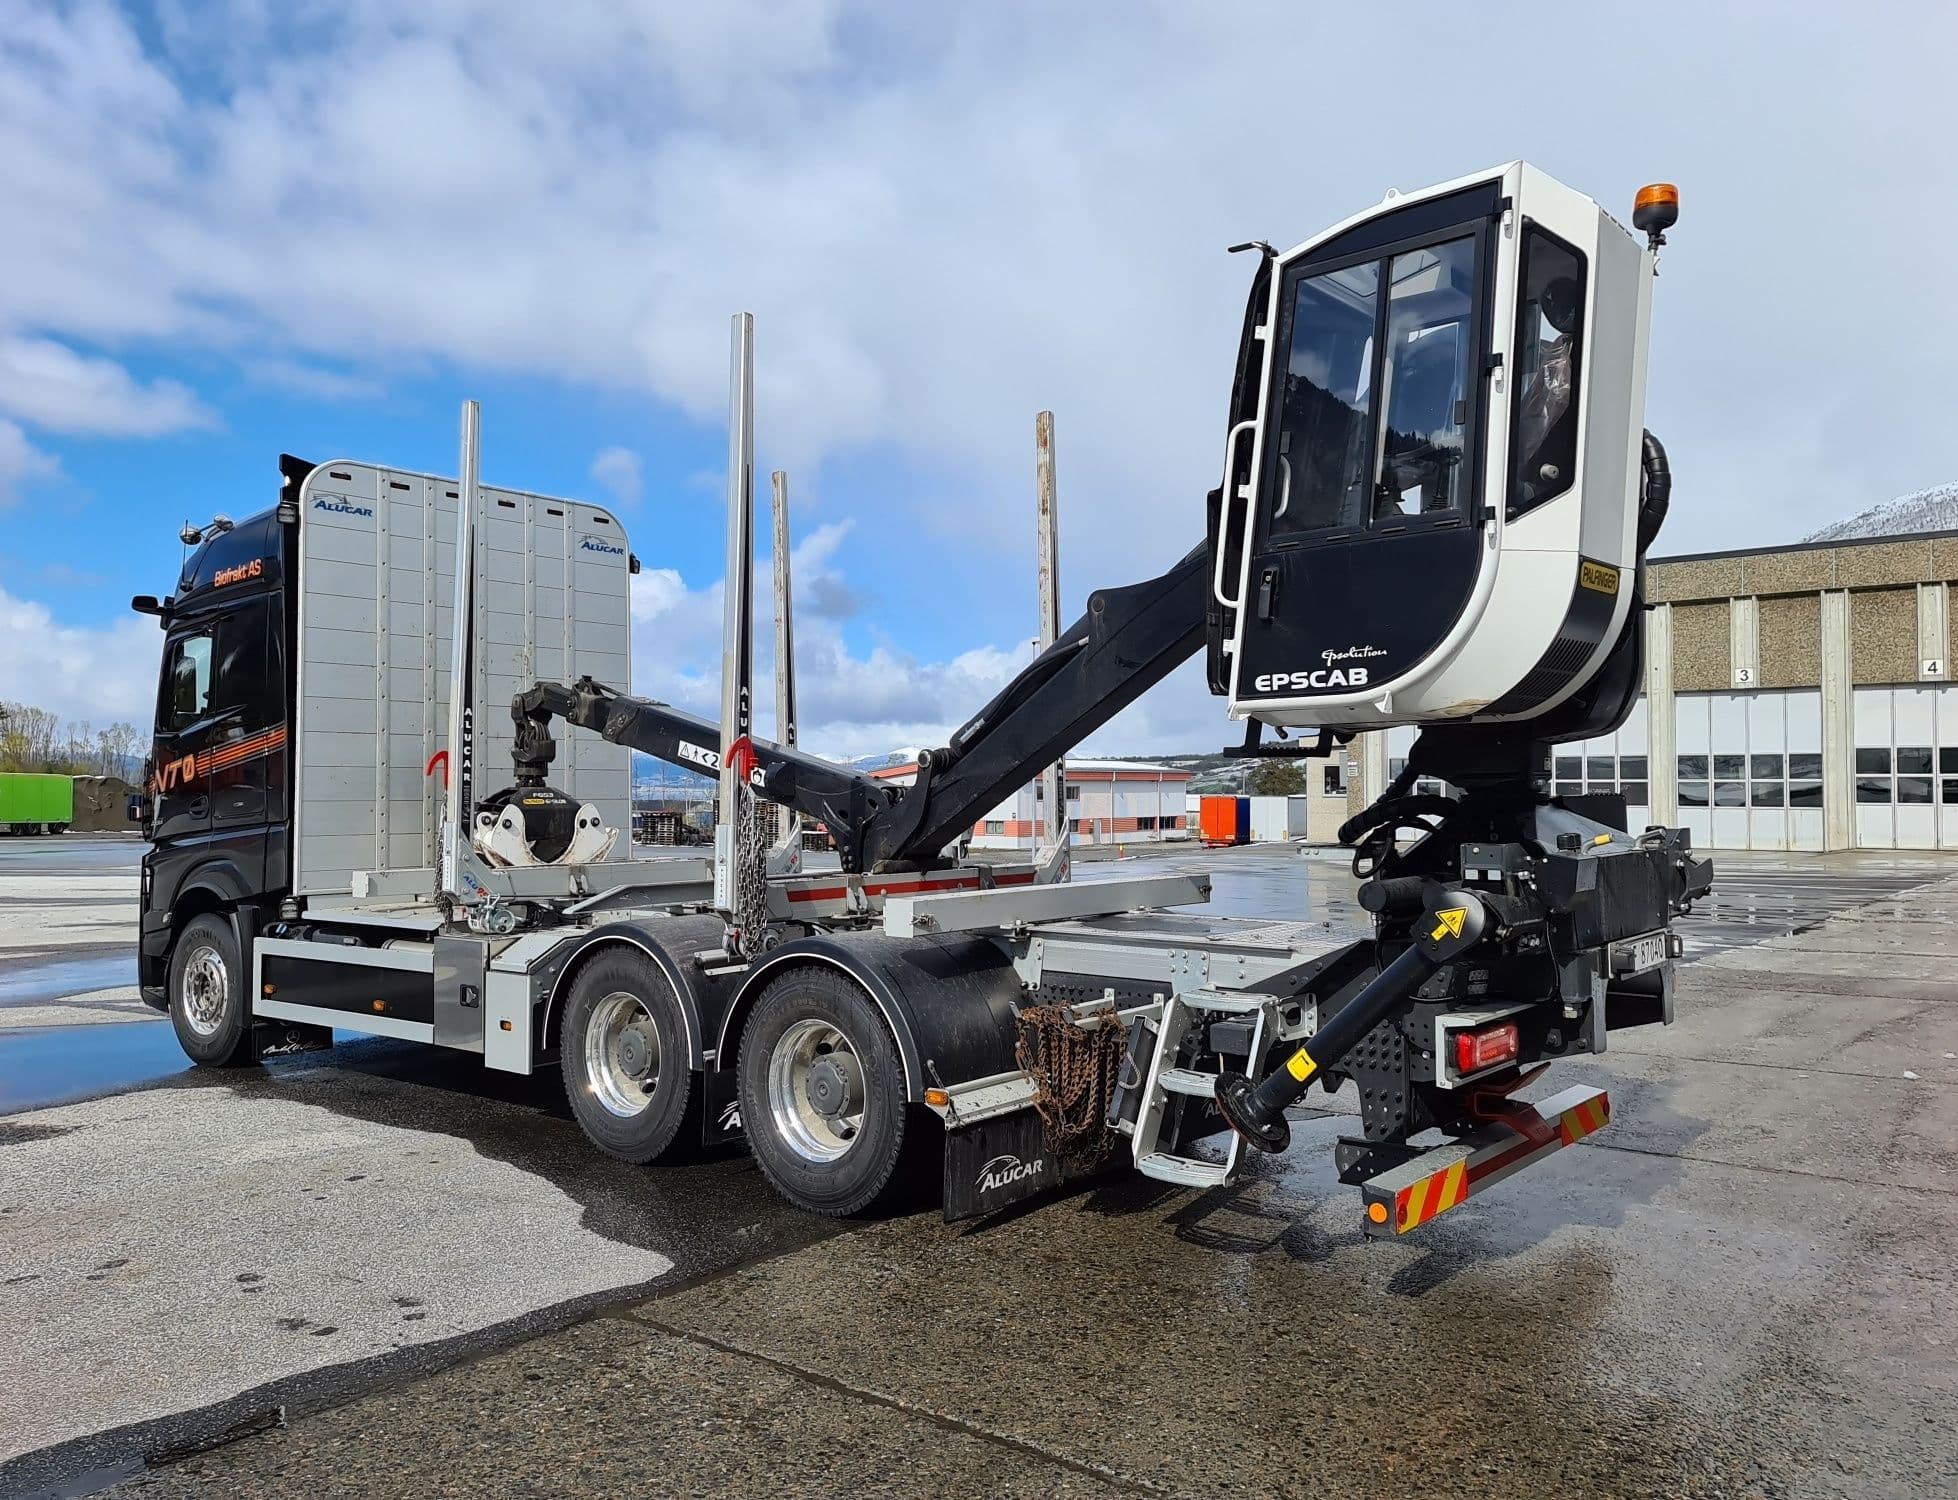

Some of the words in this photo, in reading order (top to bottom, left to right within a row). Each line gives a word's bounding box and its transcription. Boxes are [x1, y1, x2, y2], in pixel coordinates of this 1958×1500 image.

[314, 500, 373, 517] ALUCAR
[581, 541, 624, 555] ALUCAR
[248, 558, 262, 577] AS
[1321, 644, 1388, 667] Epsolution
[1740, 669, 1749, 682] 3
[1928, 661, 1938, 674] 4
[1255, 667, 1369, 692] EPSCAB
[463, 707, 473, 781] ALUCAR
[980, 1159, 1043, 1194] ALUCAR
